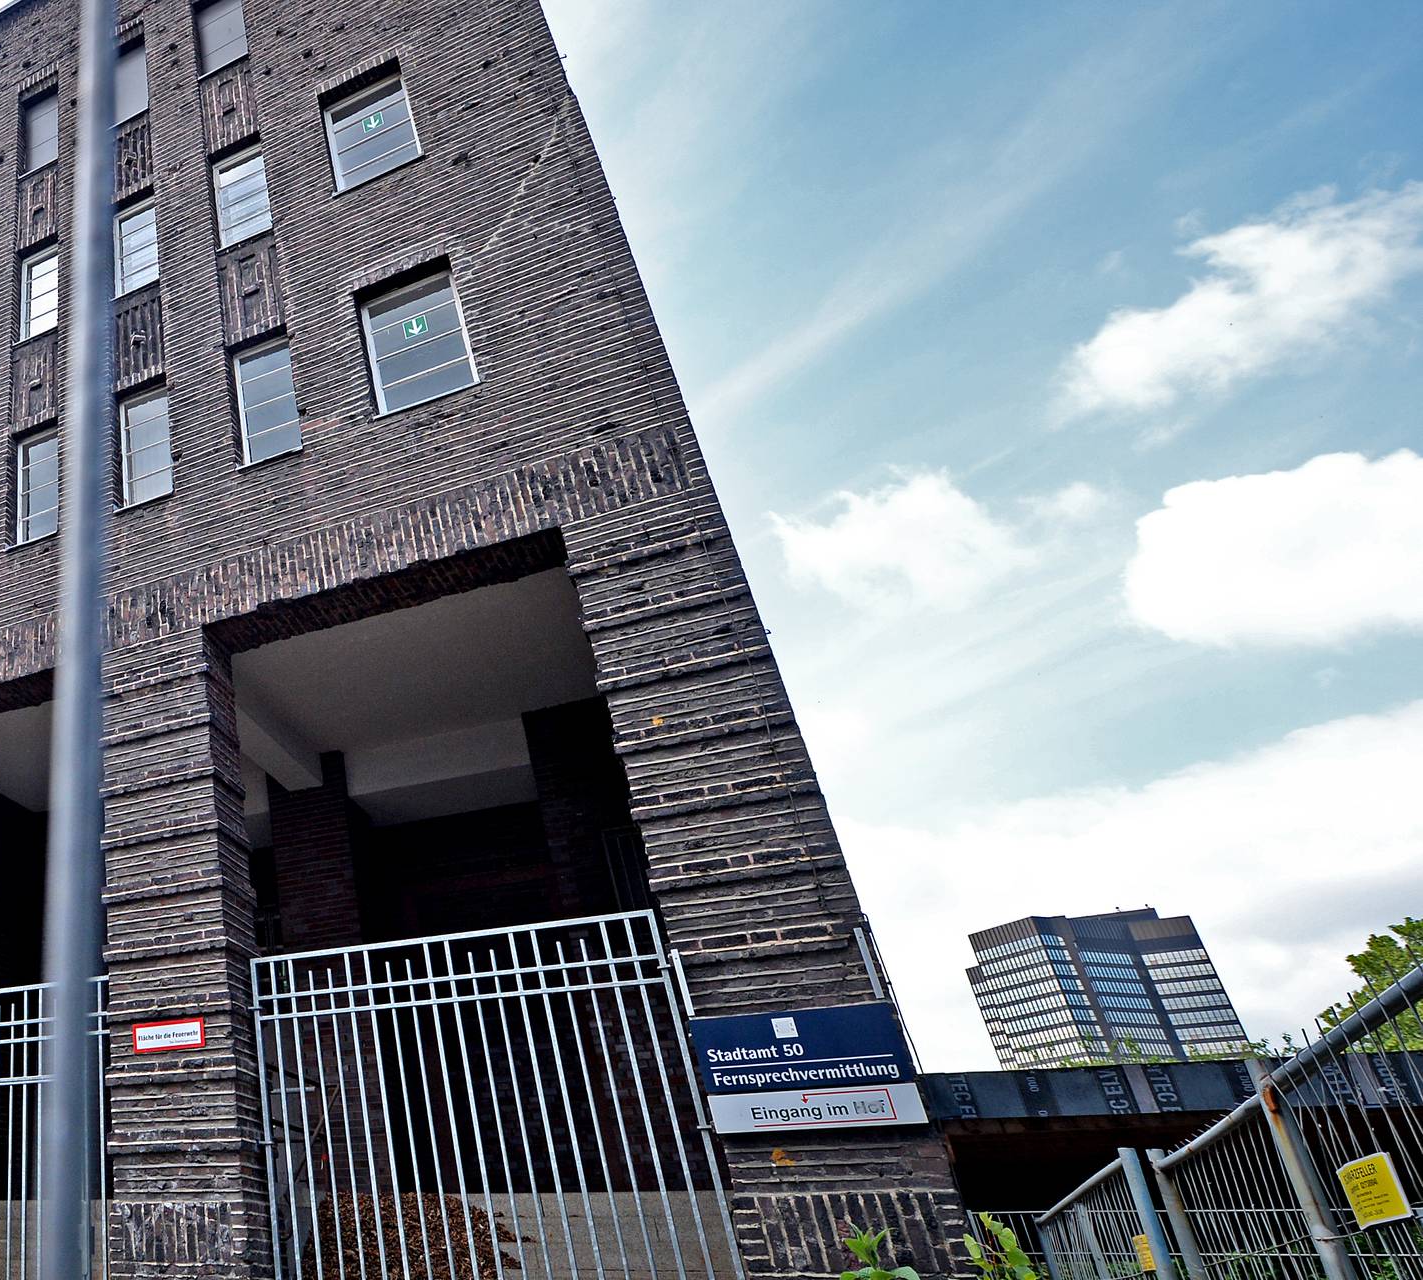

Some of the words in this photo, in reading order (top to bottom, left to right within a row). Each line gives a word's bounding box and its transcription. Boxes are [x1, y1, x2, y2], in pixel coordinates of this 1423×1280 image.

[138, 1033, 154, 1041] Fläche
[173, 1030, 198, 1038] Feuerwehr
[707, 1045, 777, 1063] Stadtamt
[783, 1043, 804, 1057] 50
[713, 1062, 900, 1087] Fernsprechvermittlung
[751, 1105, 822, 1121] Eingang
[826, 1103, 849, 1116] im
